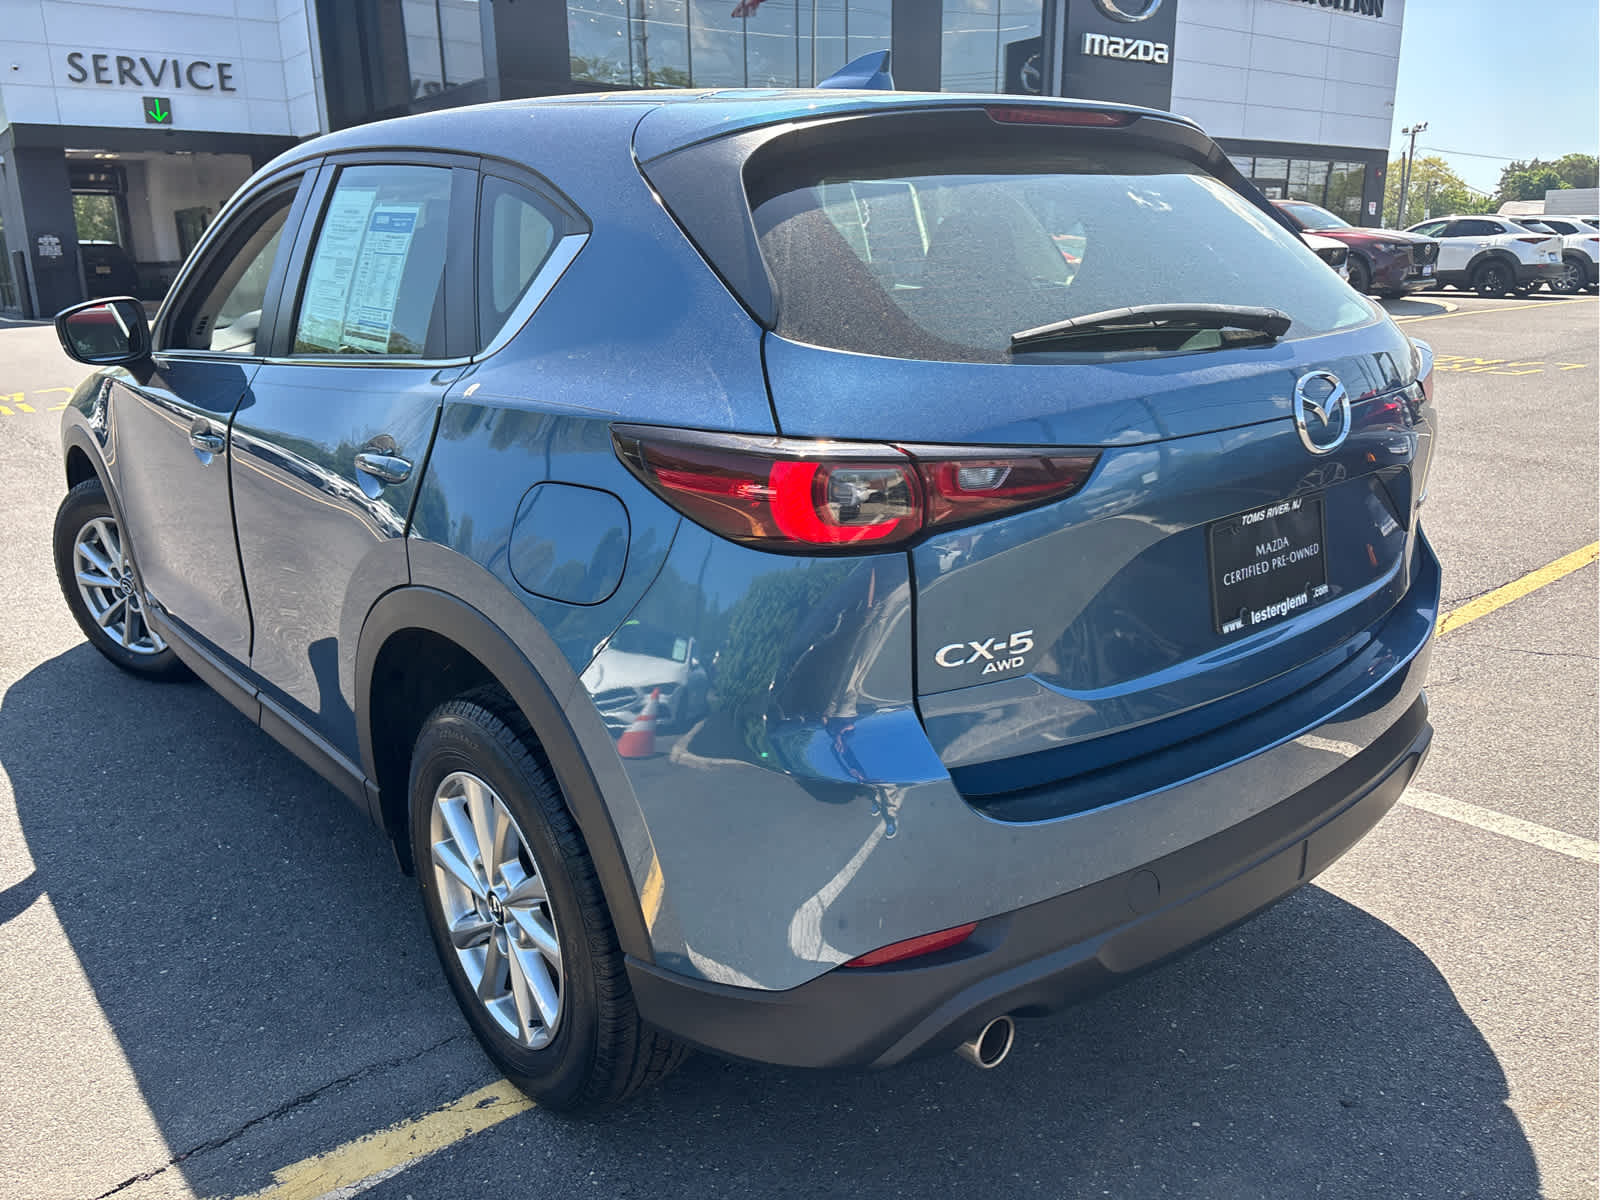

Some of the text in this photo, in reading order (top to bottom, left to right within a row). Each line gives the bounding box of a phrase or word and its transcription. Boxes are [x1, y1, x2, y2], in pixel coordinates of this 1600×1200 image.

[66, 52, 236, 92] SERVICE
[1241, 510, 1265, 526] TOMS
[1292, 498, 1303, 510] NJ
[1255, 536, 1290, 557] MAZDA
[1223, 543, 1320, 586] CERTIFIED PRE-OWNED
[935, 629, 1034, 668] CX-5
[981, 656, 1025, 675] AWD
